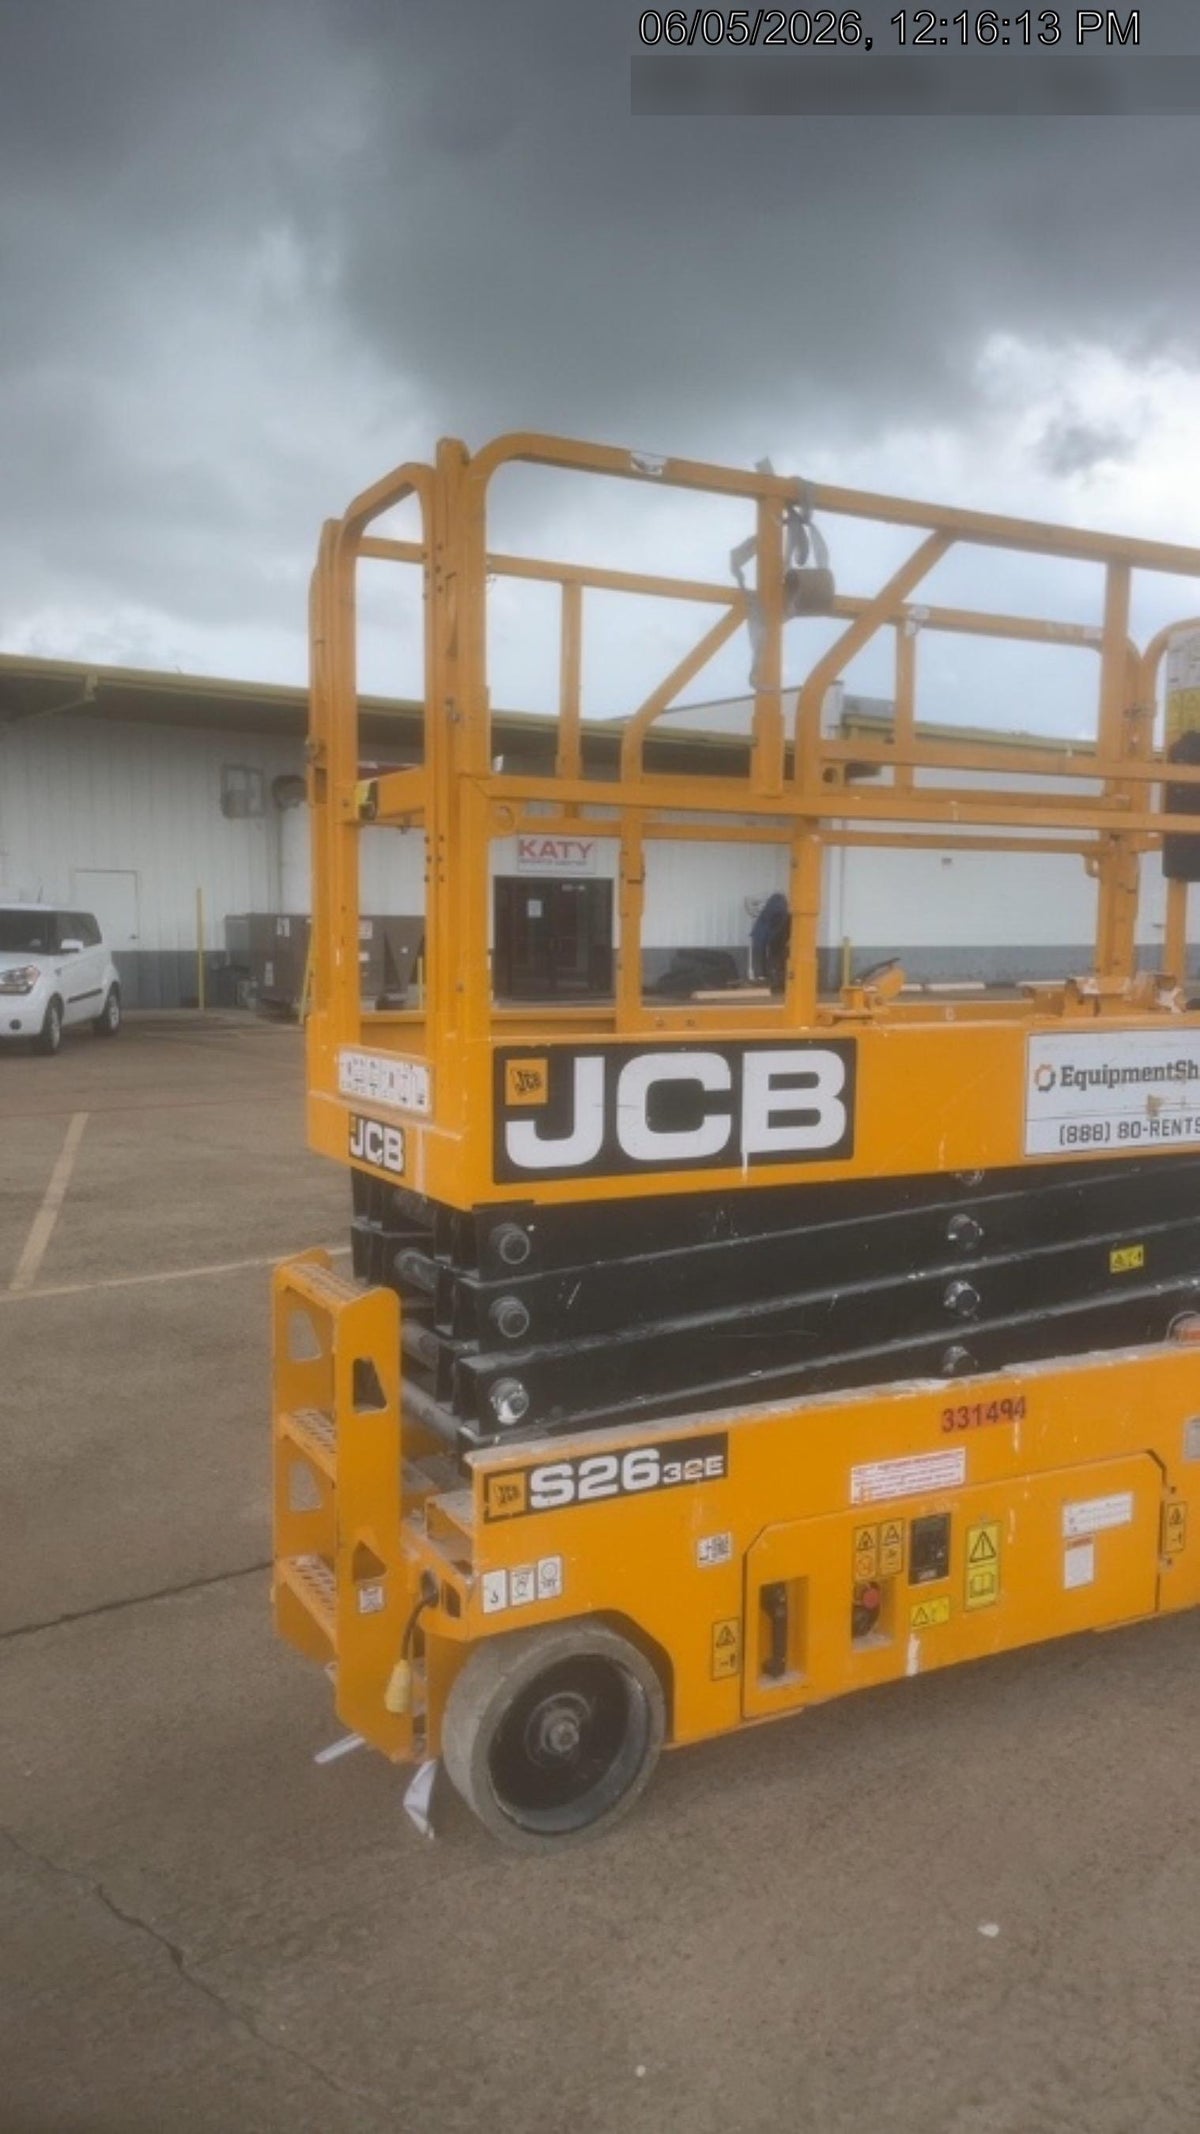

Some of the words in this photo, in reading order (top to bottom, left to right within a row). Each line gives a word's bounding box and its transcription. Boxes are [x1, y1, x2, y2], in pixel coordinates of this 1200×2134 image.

[518, 839, 593, 859] KATY
[505, 1049, 847, 1169] JCB
[350, 1118, 404, 1172] JCB
[1059, 1121, 1111, 1145] (888)
[943, 1396, 1026, 1433] 331494
